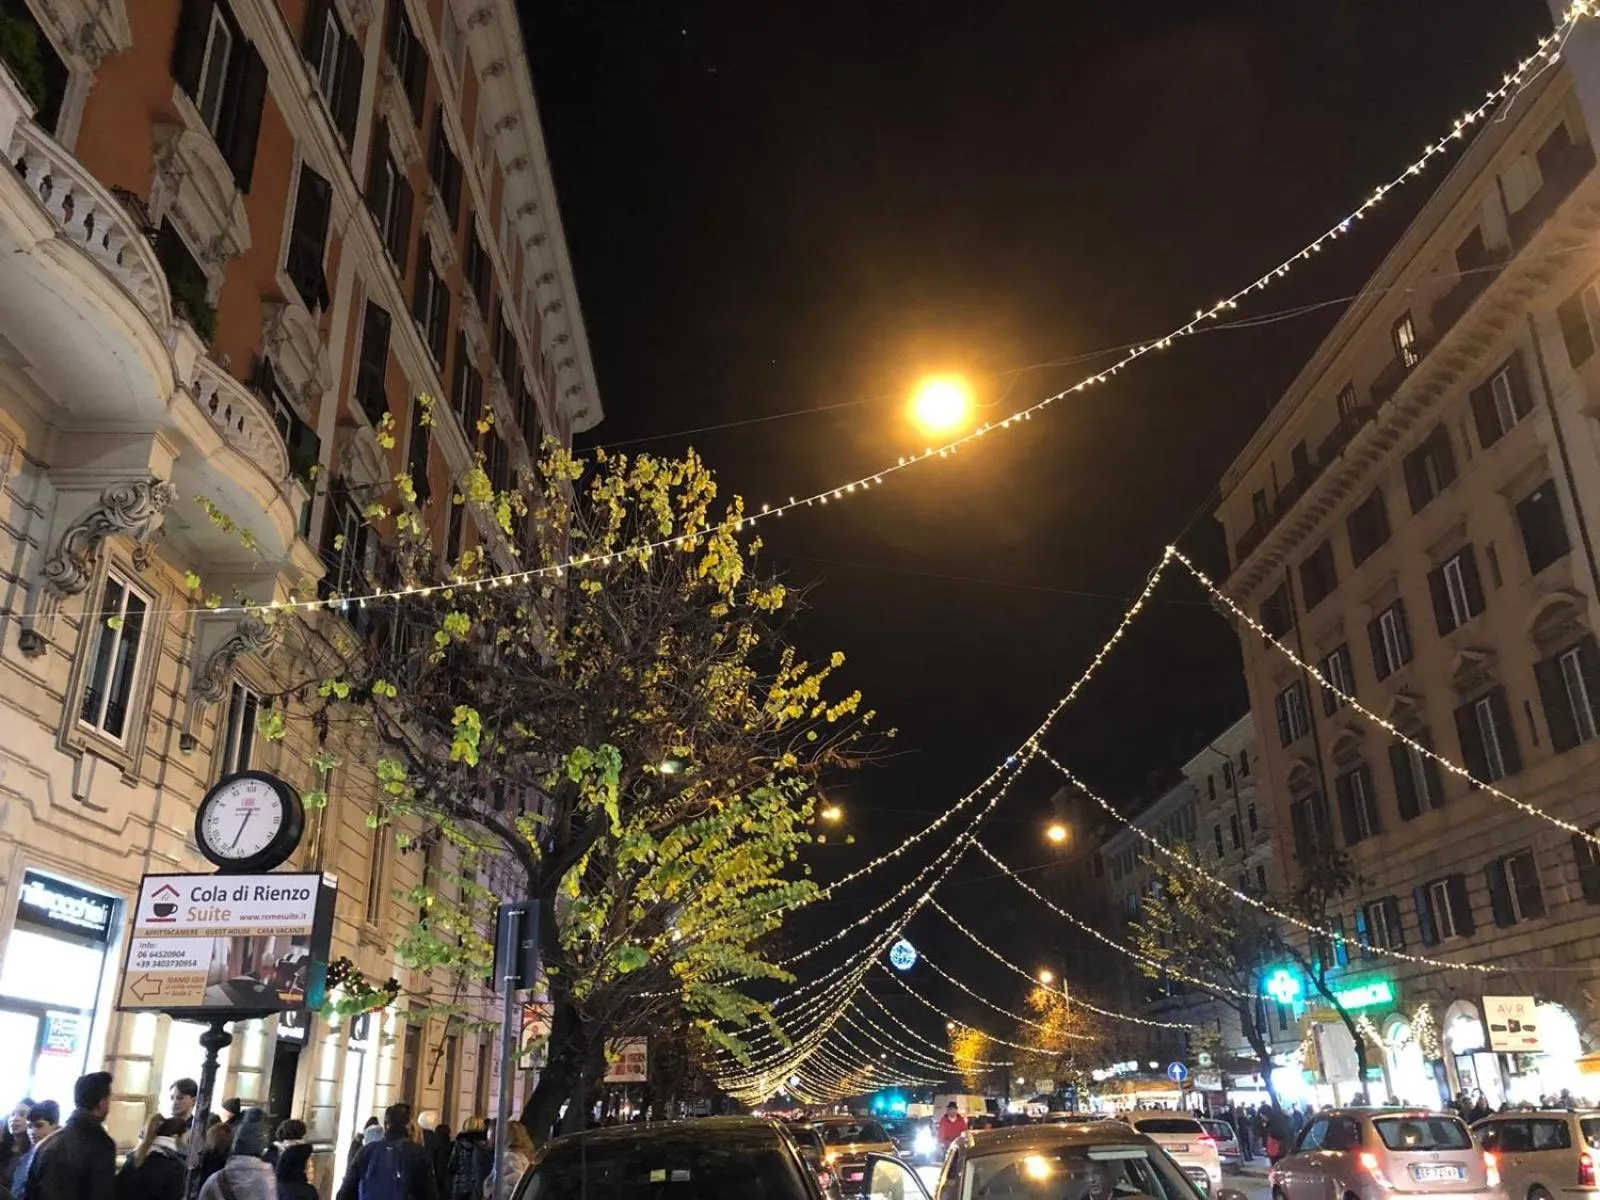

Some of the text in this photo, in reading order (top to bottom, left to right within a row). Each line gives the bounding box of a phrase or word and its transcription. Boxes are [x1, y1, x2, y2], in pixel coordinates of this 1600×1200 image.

[190, 885, 310, 902] Cola di Rienzo
[186, 906, 232, 922] Suite
